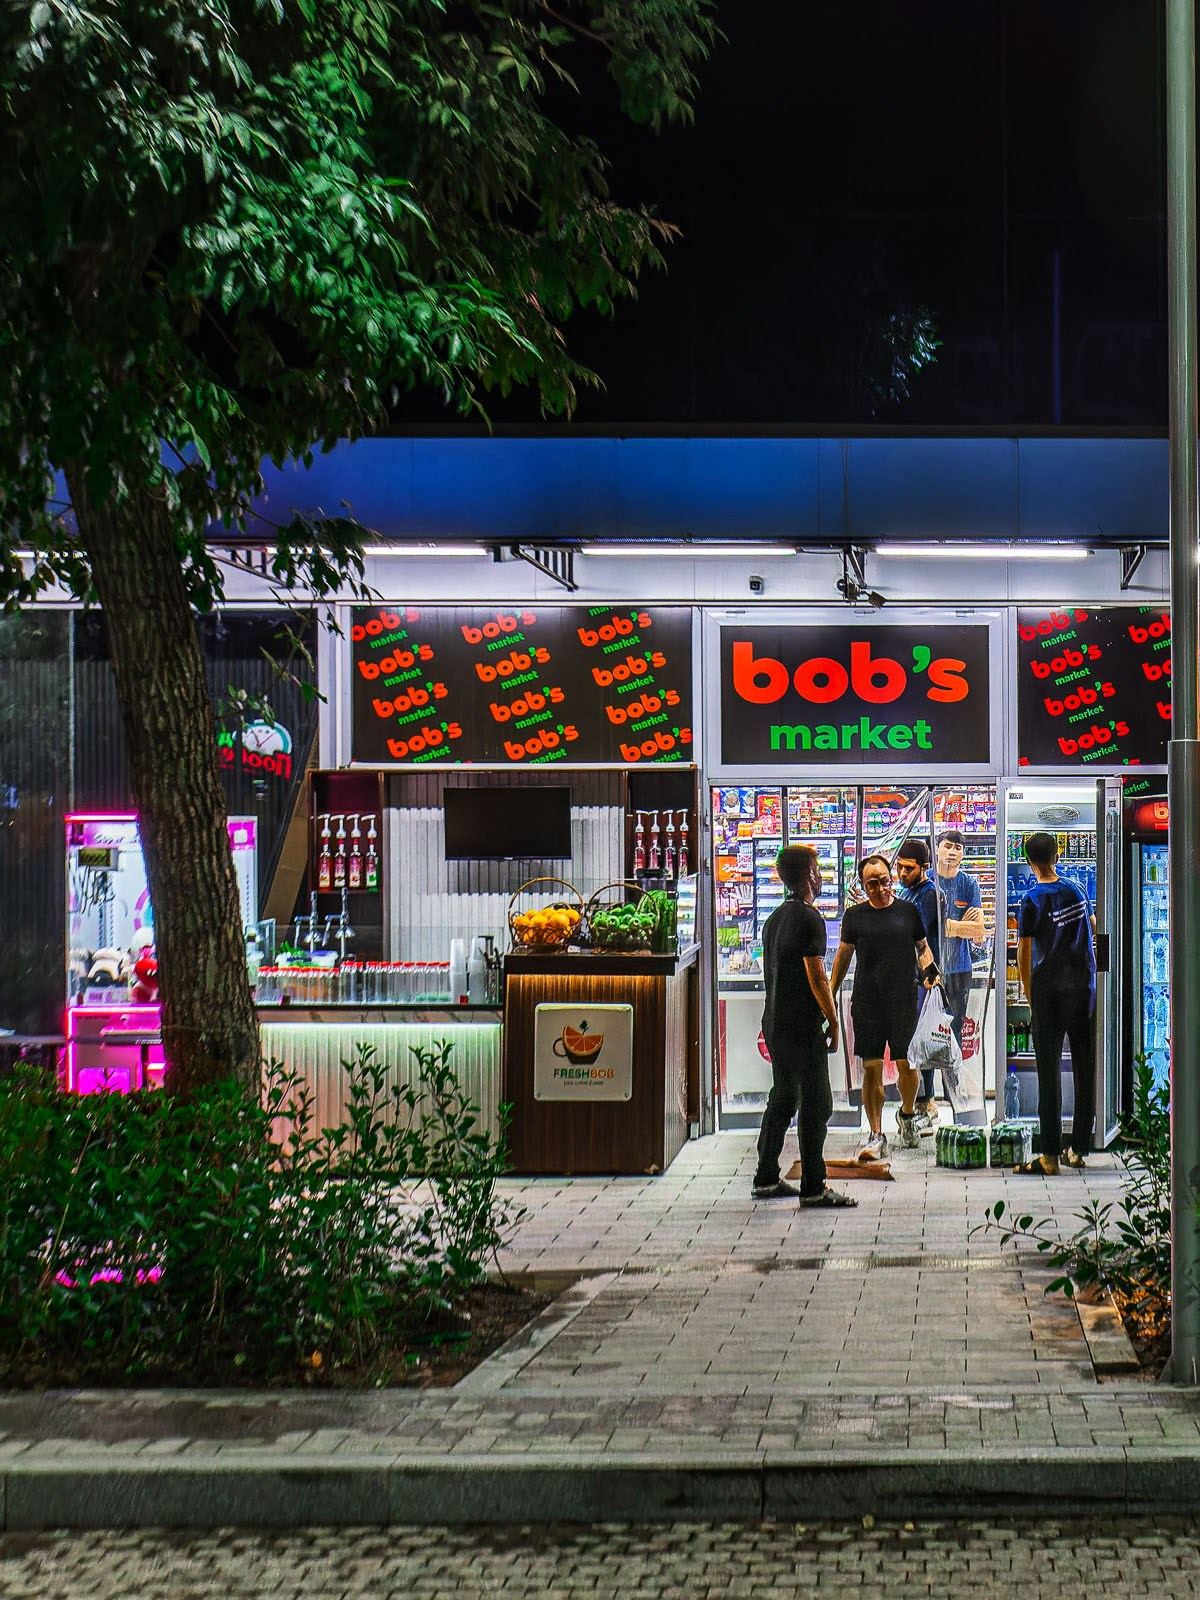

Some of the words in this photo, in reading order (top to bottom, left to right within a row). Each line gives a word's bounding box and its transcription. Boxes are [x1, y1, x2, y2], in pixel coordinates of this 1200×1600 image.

[370, 629, 408, 648] market
[462, 610, 536, 645] bob's
[487, 633, 524, 651] market
[577, 612, 652, 647] bob's
[603, 635, 640, 654] market
[1041, 630, 1077, 648] market
[358, 644, 434, 680] bob's
[384, 668, 422, 687] market
[475, 647, 550, 682] bob's
[592, 651, 666, 686] bob's
[733, 641, 969, 704] bob's
[1030, 644, 1102, 678] bob's
[1055, 668, 1090, 686] market
[501, 670, 539, 690] market
[617, 675, 655, 694] market
[373, 682, 448, 718] bob's
[398, 706, 436, 725] market
[490, 687, 564, 722] bob's
[606, 689, 680, 724] bob's
[1044, 682, 1116, 716] bob's
[1069, 705, 1103, 723] market
[515, 710, 553, 729] market
[631, 713, 669, 732] market
[770, 716, 933, 750] market
[387, 722, 462, 758] bob's
[504, 724, 579, 760] bob's
[1058, 721, 1129, 755] bob's
[1083, 744, 1117, 762] market
